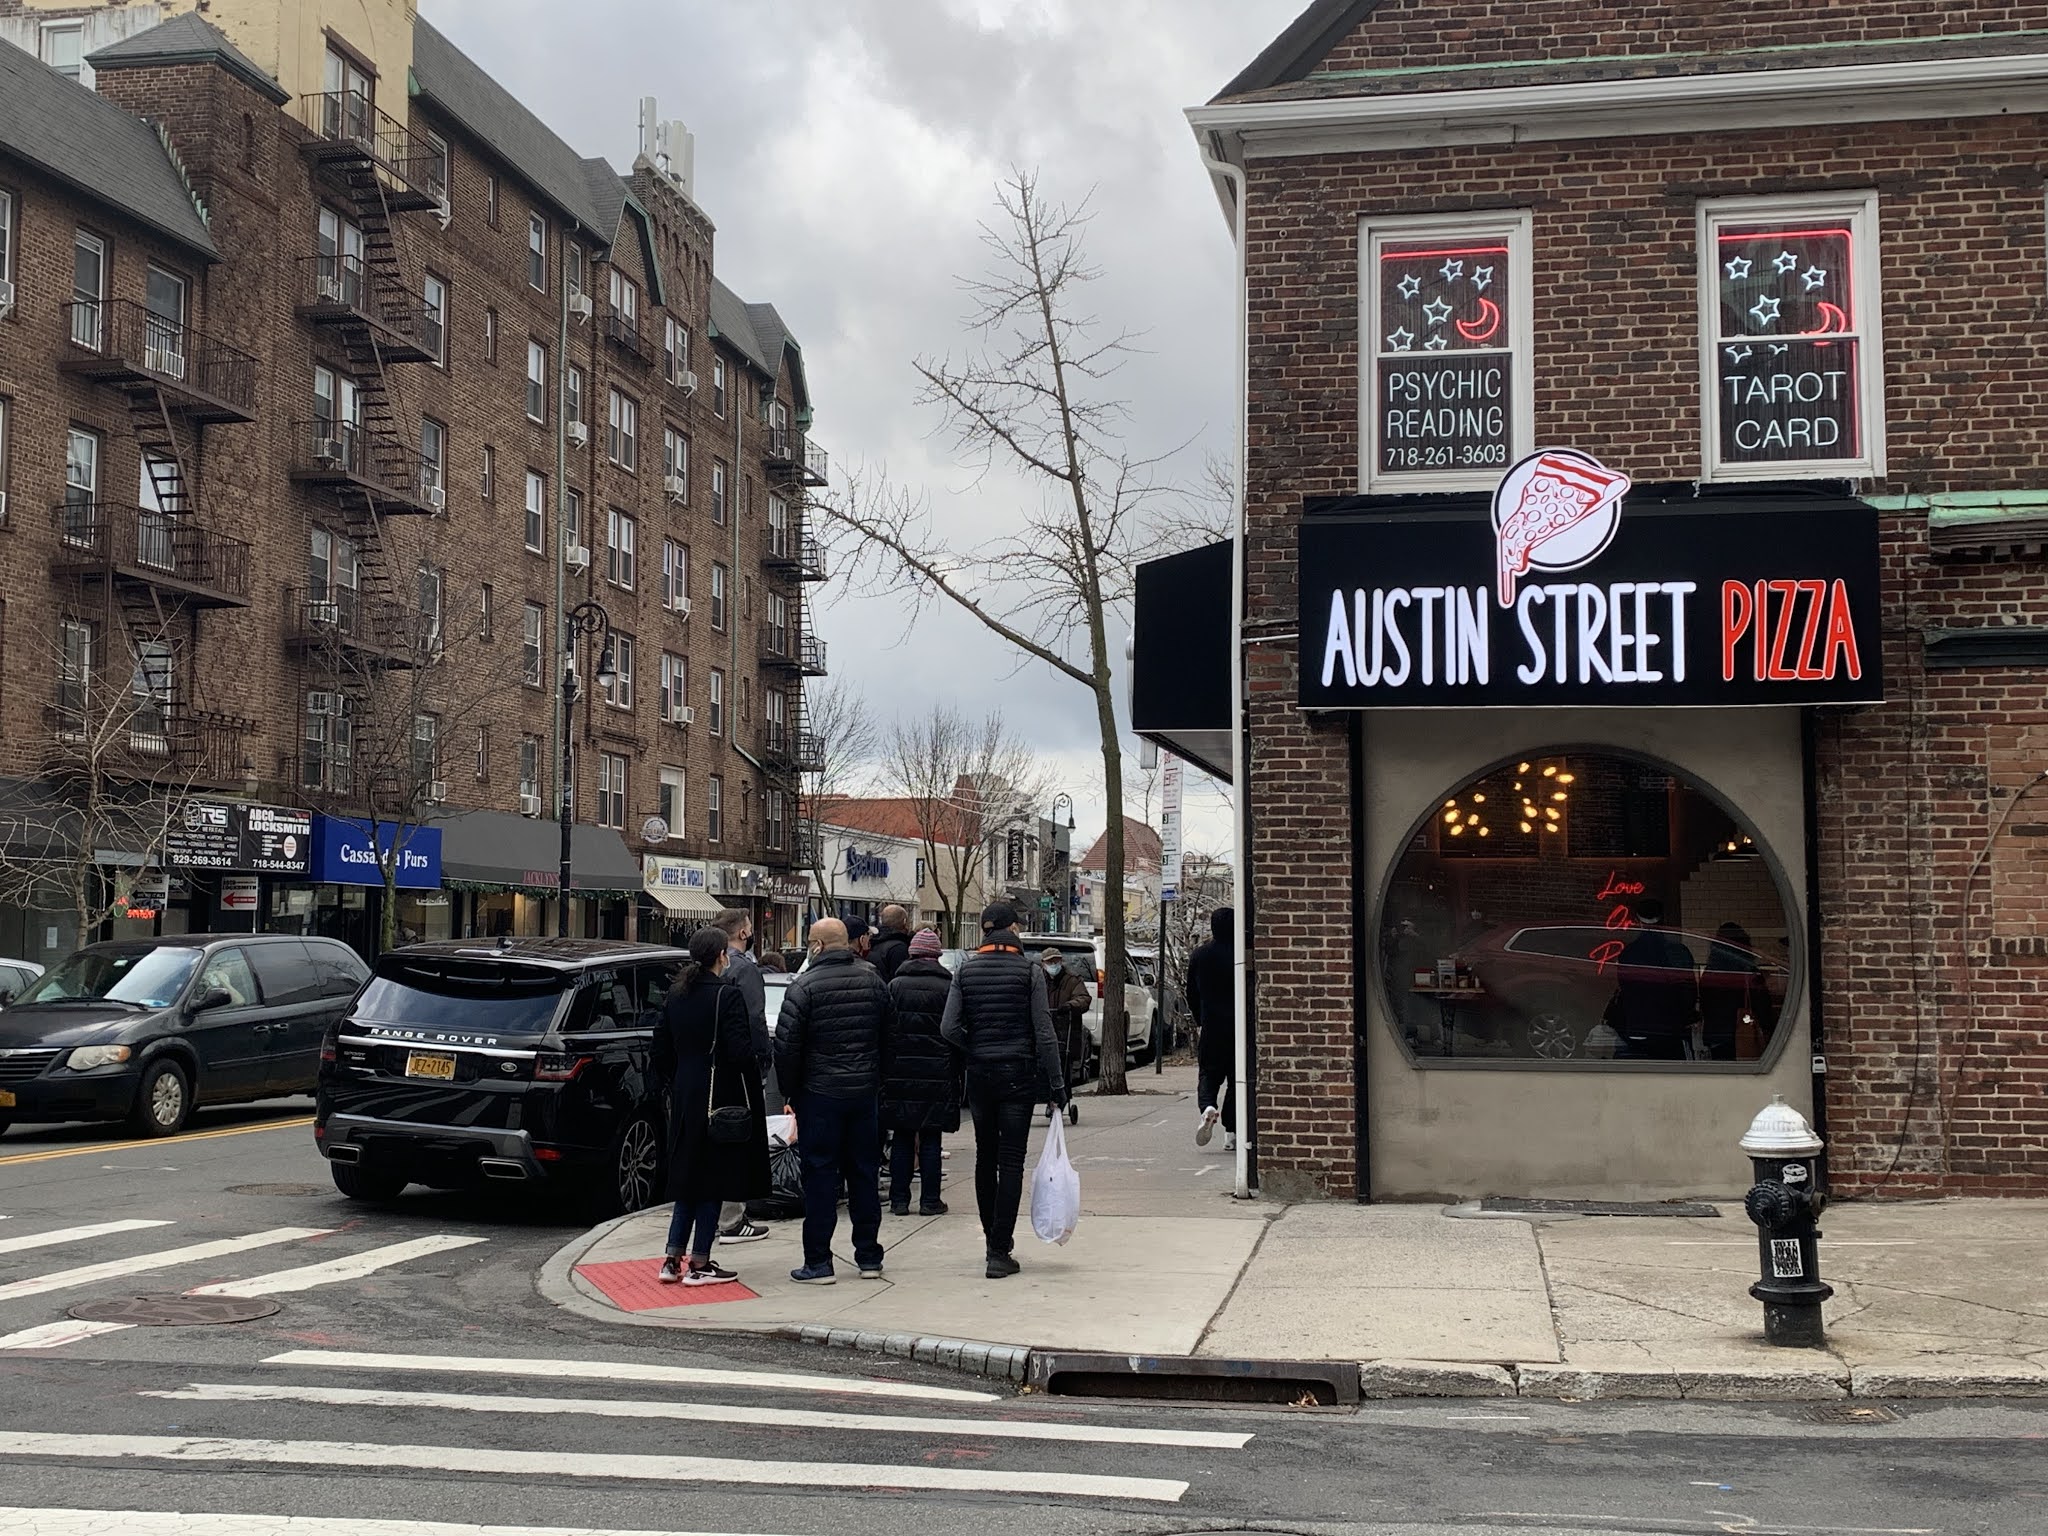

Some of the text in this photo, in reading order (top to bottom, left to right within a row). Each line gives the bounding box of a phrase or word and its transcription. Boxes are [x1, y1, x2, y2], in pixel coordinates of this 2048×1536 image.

[1389, 367, 1502, 402] PSYCHIC
[1724, 371, 1847, 405] TAROT
[1387, 406, 1504, 439] READING
[1735, 416, 1839, 450] CARD
[1387, 444, 1506, 467] 718-261-3603
[1321, 578, 1862, 687] AUSTIN STREET PIZZA
[249, 808, 274, 821] ABCO
[248, 820, 310, 835] LOCKSMITH
[173, 854, 232, 867] 929-269-3614
[252, 859, 306, 871] 718-544-8347
[404, 849, 428, 870] Furs
[661, 867, 679, 885] CHEESE
[687, 869, 703, 886] WORLD
[1597, 870, 1645, 900] Love
[783, 883, 807, 896] SUSHI
[370, 1028, 498, 1045] RANGE ROVER
